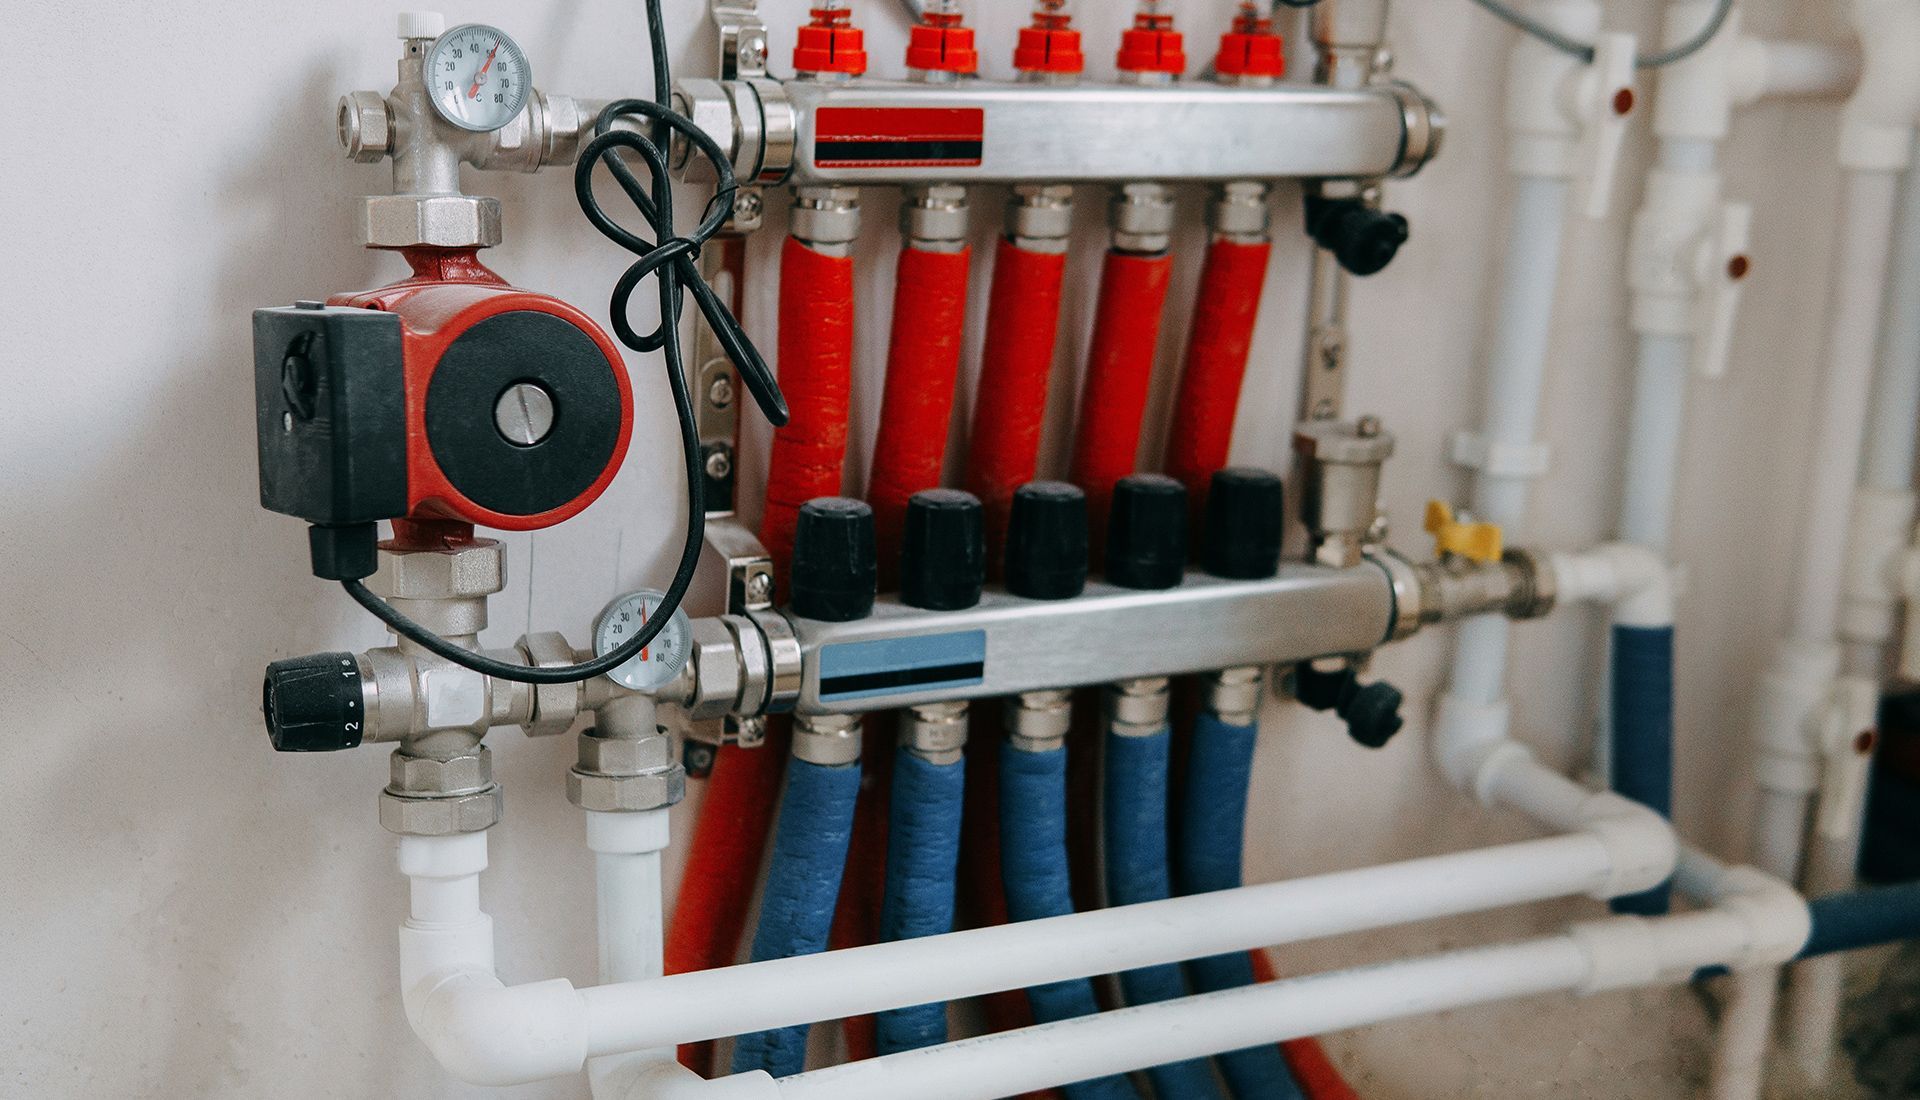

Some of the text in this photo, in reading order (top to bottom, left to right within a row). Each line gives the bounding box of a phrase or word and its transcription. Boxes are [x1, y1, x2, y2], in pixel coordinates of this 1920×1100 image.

[470, 43, 479, 53] 40
[452, 49, 462, 59] 30
[445, 62, 455, 71] 20
[497, 62, 507, 72] 60
[444, 81, 453, 90] 10
[500, 79, 509, 88] 70
[494, 94, 503, 103] 80
[620, 612, 630, 622] 30
[612, 624, 623, 634] 20
[663, 640, 671, 649] 70
[656, 653, 665, 662] 80
[345, 721, 359, 731] 2
